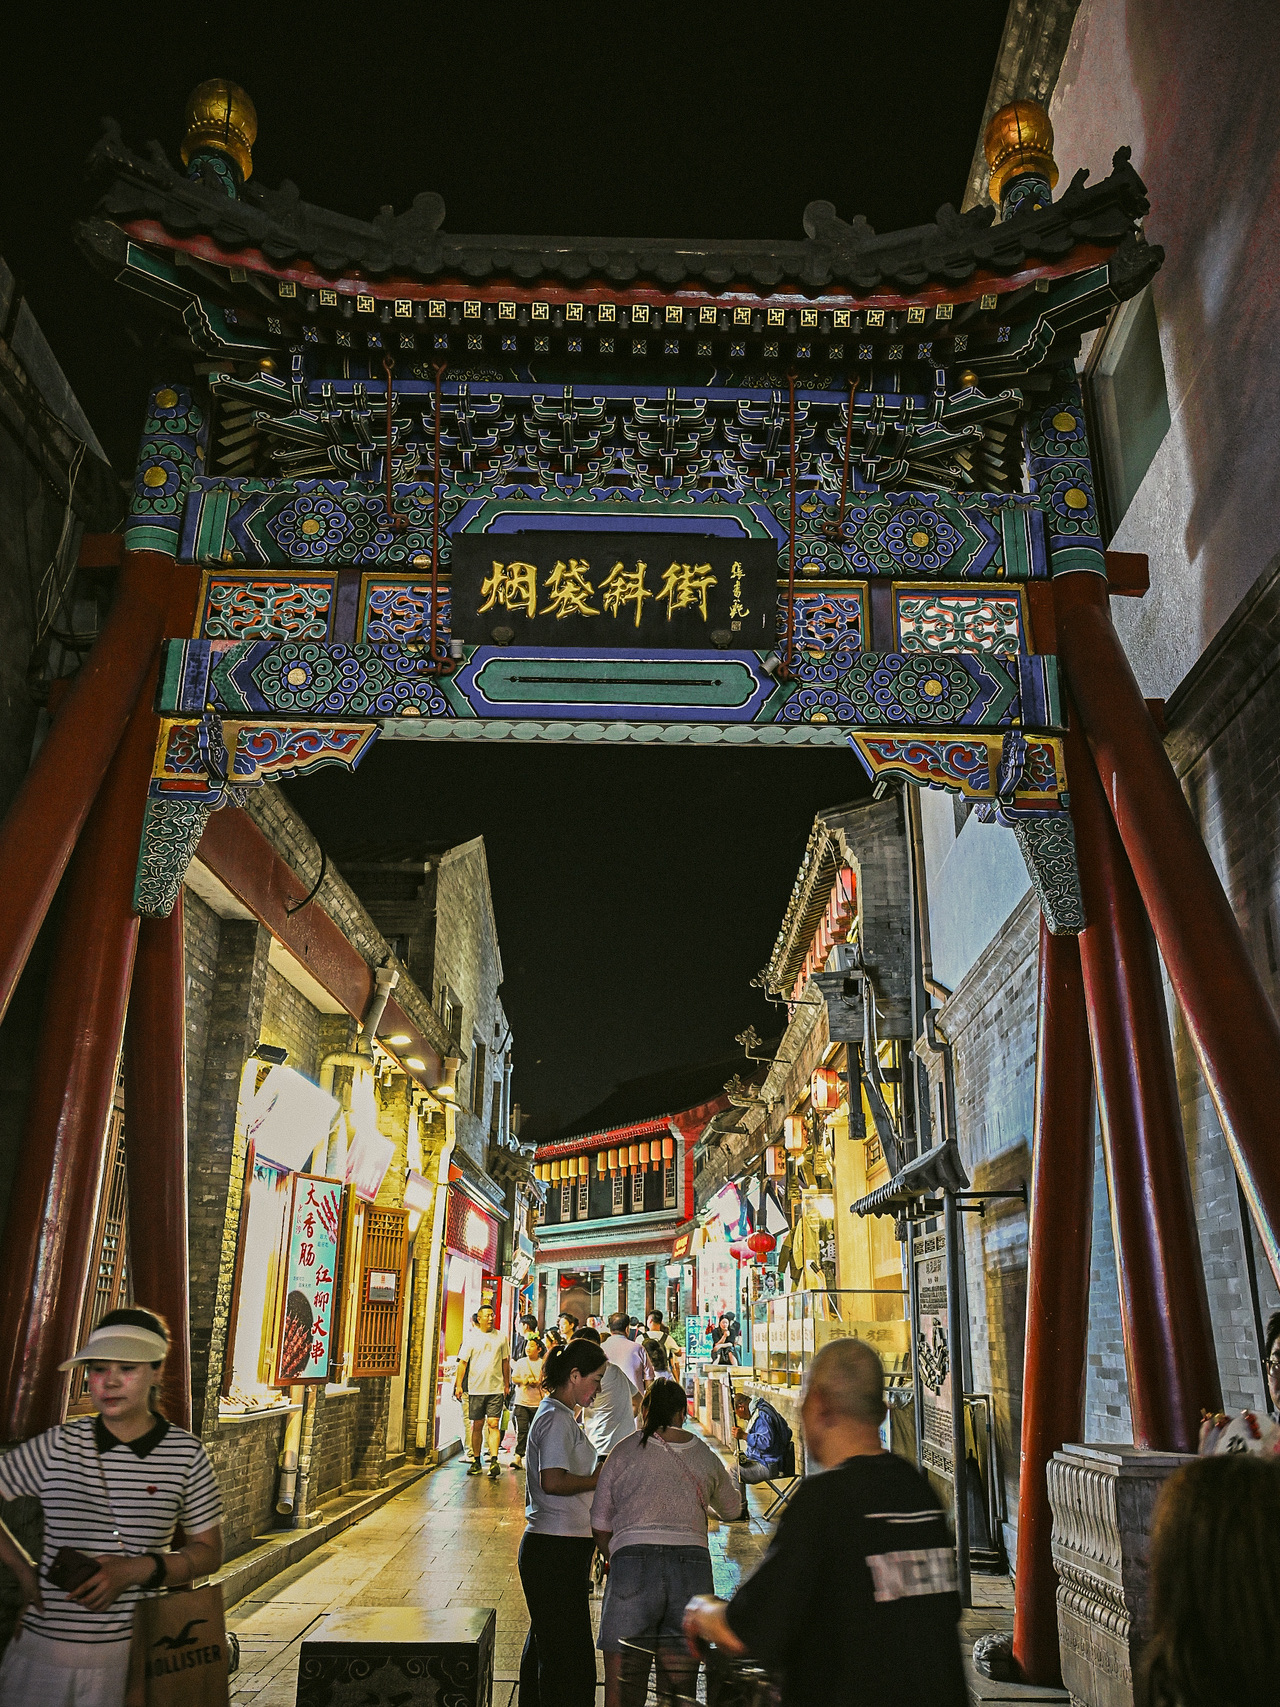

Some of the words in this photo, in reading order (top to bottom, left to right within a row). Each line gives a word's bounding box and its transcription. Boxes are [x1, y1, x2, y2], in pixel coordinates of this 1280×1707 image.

[477, 558, 718, 628] 烟袋斜街
[298, 1182, 320, 1267] 大香肠
[310, 1263, 333, 1365] 红柳大串
